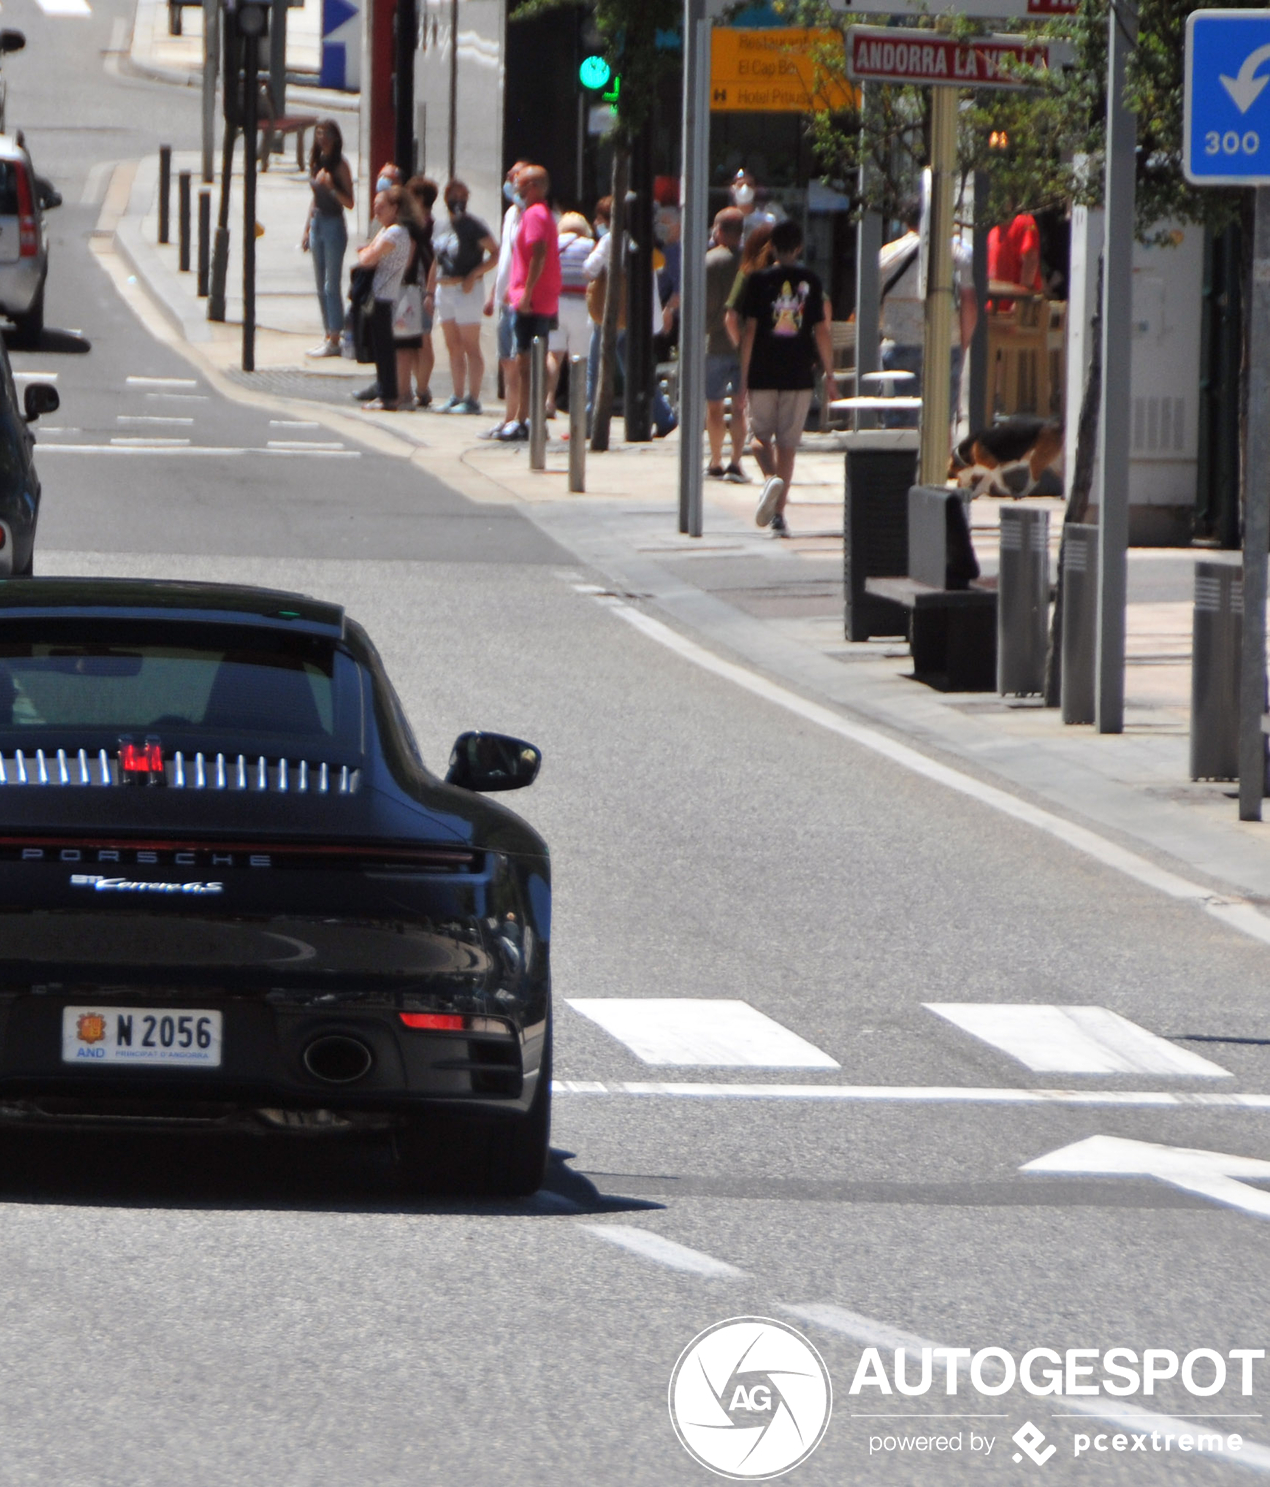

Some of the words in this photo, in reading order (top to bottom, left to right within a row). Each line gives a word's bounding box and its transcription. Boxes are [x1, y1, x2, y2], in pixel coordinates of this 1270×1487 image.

[856, 41, 948, 74] ANDORRA
[954, 50, 978, 77] LA
[1205, 131, 1260, 156] 300
[22, 849, 272, 866] PORSCHE
[117, 1014, 133, 1046] N
[142, 1015, 211, 1048] 2056
[77, 1047, 105, 1058] AND
